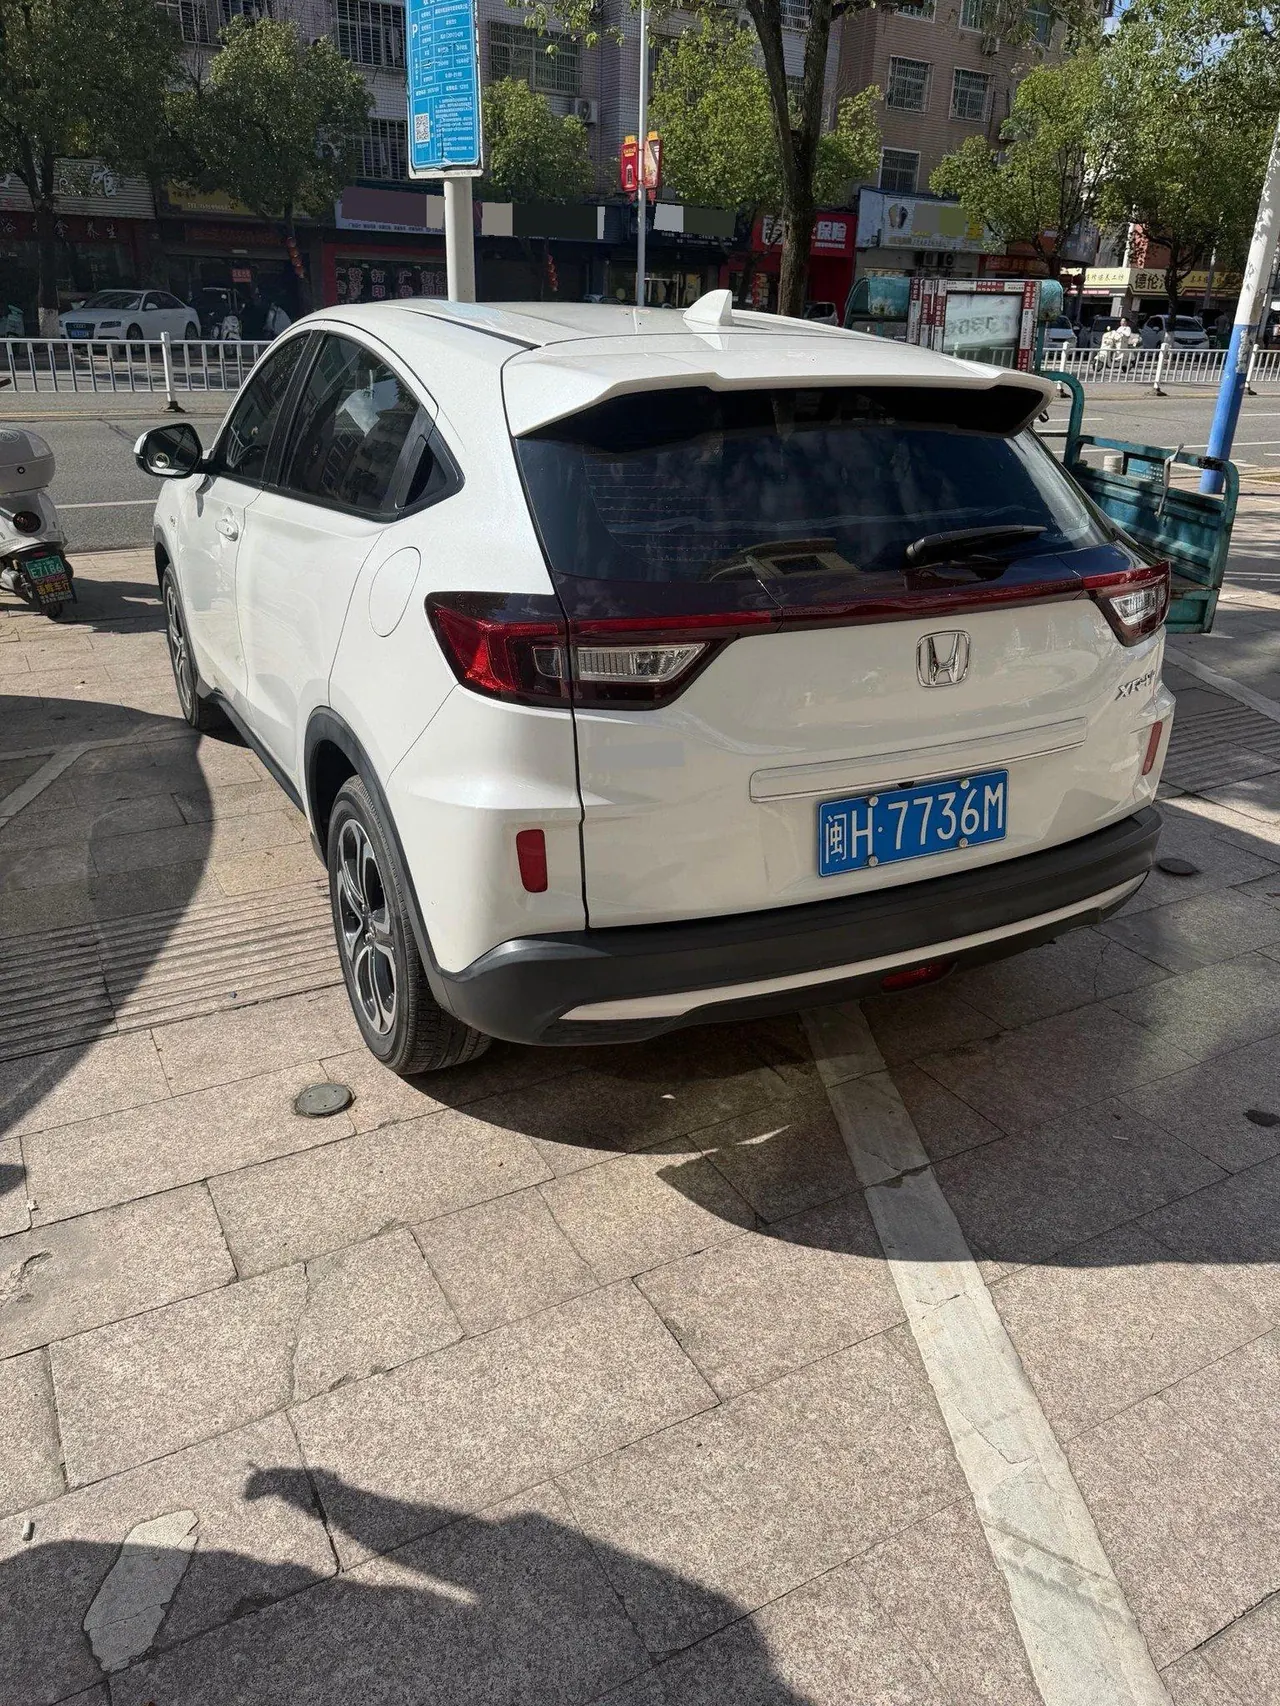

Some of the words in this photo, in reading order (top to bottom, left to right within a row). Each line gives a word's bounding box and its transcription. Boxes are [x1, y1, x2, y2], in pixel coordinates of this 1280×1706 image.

[812, 221, 847, 240] 保险
[371, 268, 386, 298] 打印
[398, 270, 414, 298] 广告
[826, 782, 1004, 864] 闽H·7736M
